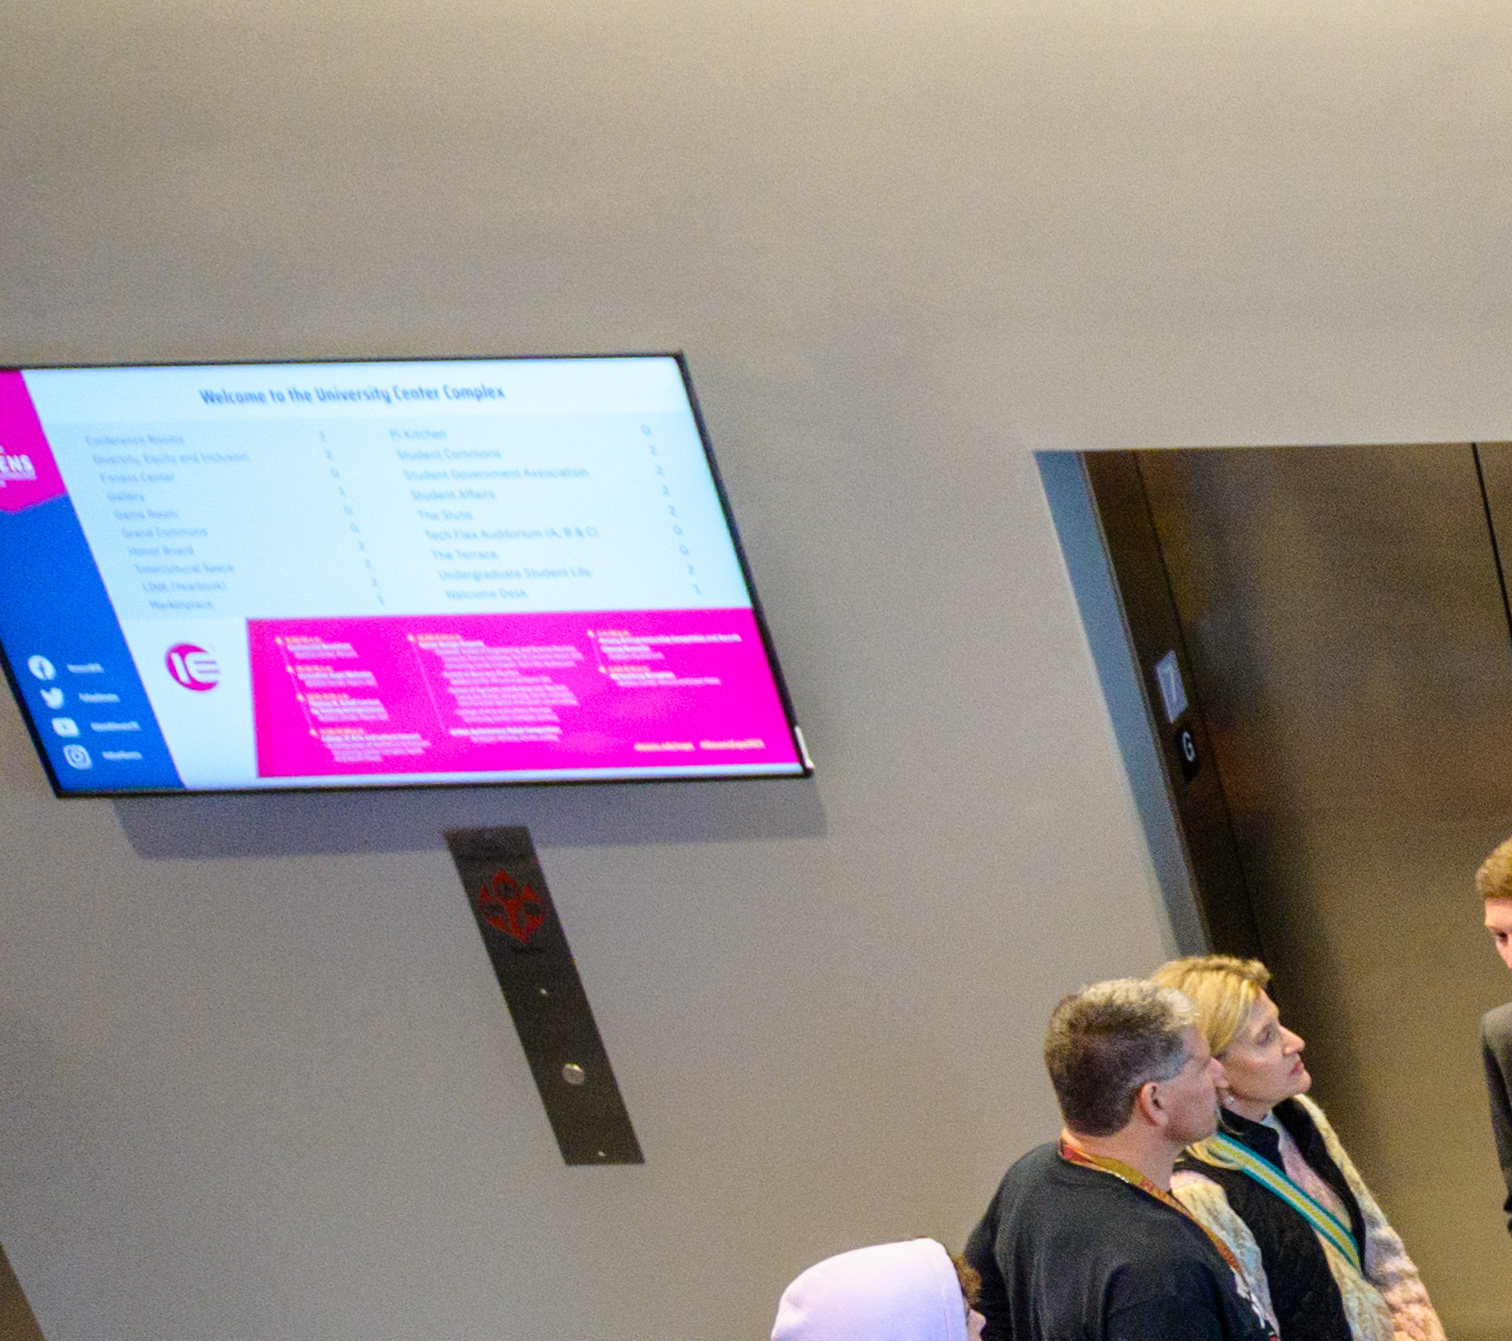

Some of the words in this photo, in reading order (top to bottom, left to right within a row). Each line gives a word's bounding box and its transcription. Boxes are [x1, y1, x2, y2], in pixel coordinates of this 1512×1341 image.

[199, 390, 267, 404] Welcome
[269, 389, 285, 403] to
[288, 388, 312, 402] the
[315, 388, 390, 403] University
[392, 386, 439, 400] Center
[443, 384, 505, 401] Complex
